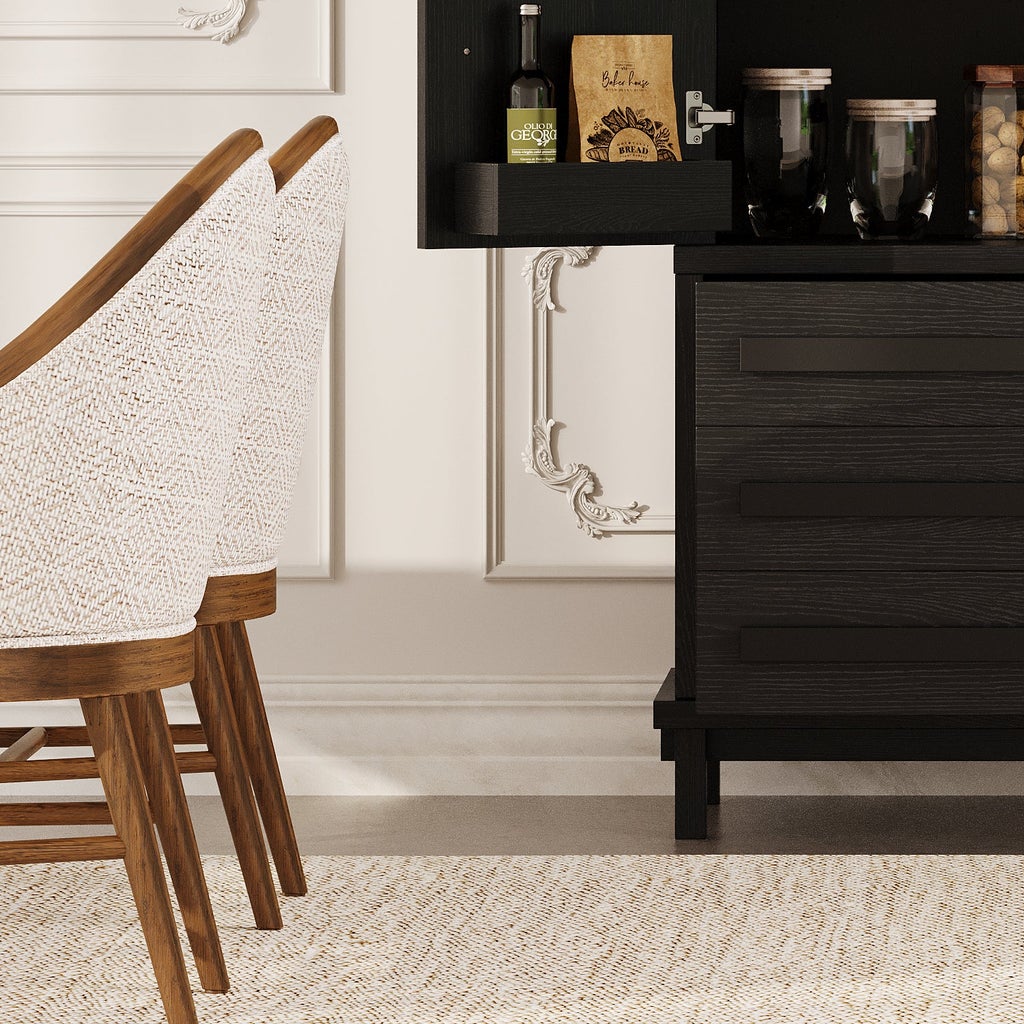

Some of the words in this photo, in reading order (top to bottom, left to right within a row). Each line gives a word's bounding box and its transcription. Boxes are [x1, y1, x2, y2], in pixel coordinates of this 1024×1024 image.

[523, 122, 546, 130] OLIO
[546, 122, 553, 130] DI
[618, 145, 649, 155] BREAD
